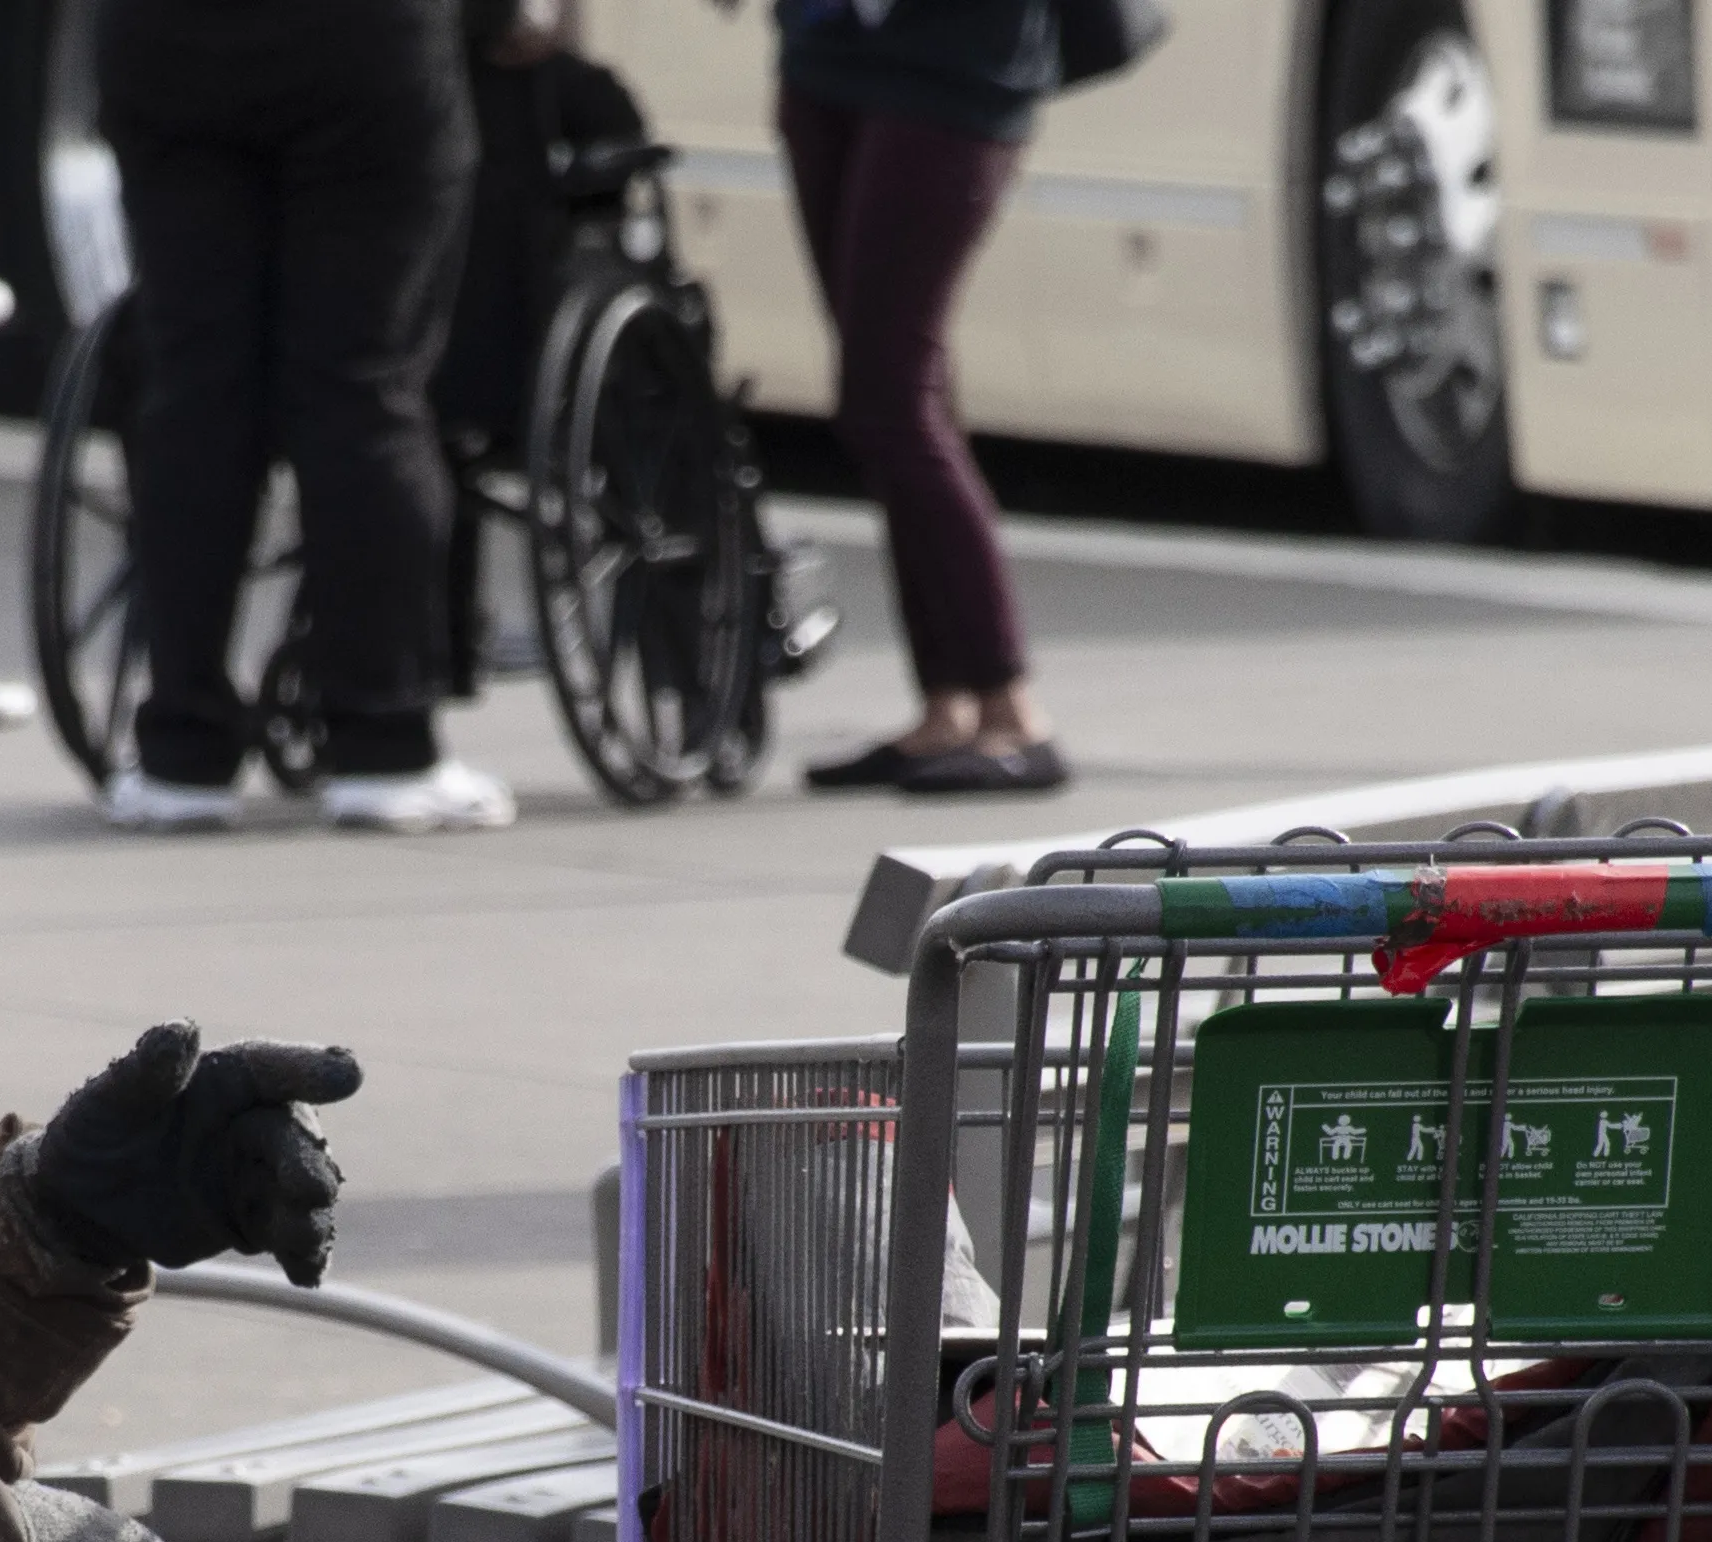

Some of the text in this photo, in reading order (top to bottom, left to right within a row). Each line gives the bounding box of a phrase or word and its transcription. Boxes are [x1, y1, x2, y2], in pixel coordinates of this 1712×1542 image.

[1321, 1091, 1343, 1101] Your
[1344, 1090, 1368, 1100] child
[1370, 1091, 1386, 1099] can
[1388, 1088, 1402, 1099] fall
[1404, 1089, 1419, 1098] out
[1421, 1088, 1431, 1098] of
[1526, 1087, 1560, 1096] serious
[1562, 1086, 1585, 1095] head
[1260, 1105, 1285, 1211] WARNING
[1294, 1165, 1330, 1175] ALWAYS
[1396, 1164, 1418, 1174] STAY
[1533, 1161, 1553, 1170] child
[1337, 1200, 1360, 1210] ONLY
[1512, 1212, 1557, 1222] CALIFORNIA
[1249, 1223, 1347, 1255] MOLLIE
